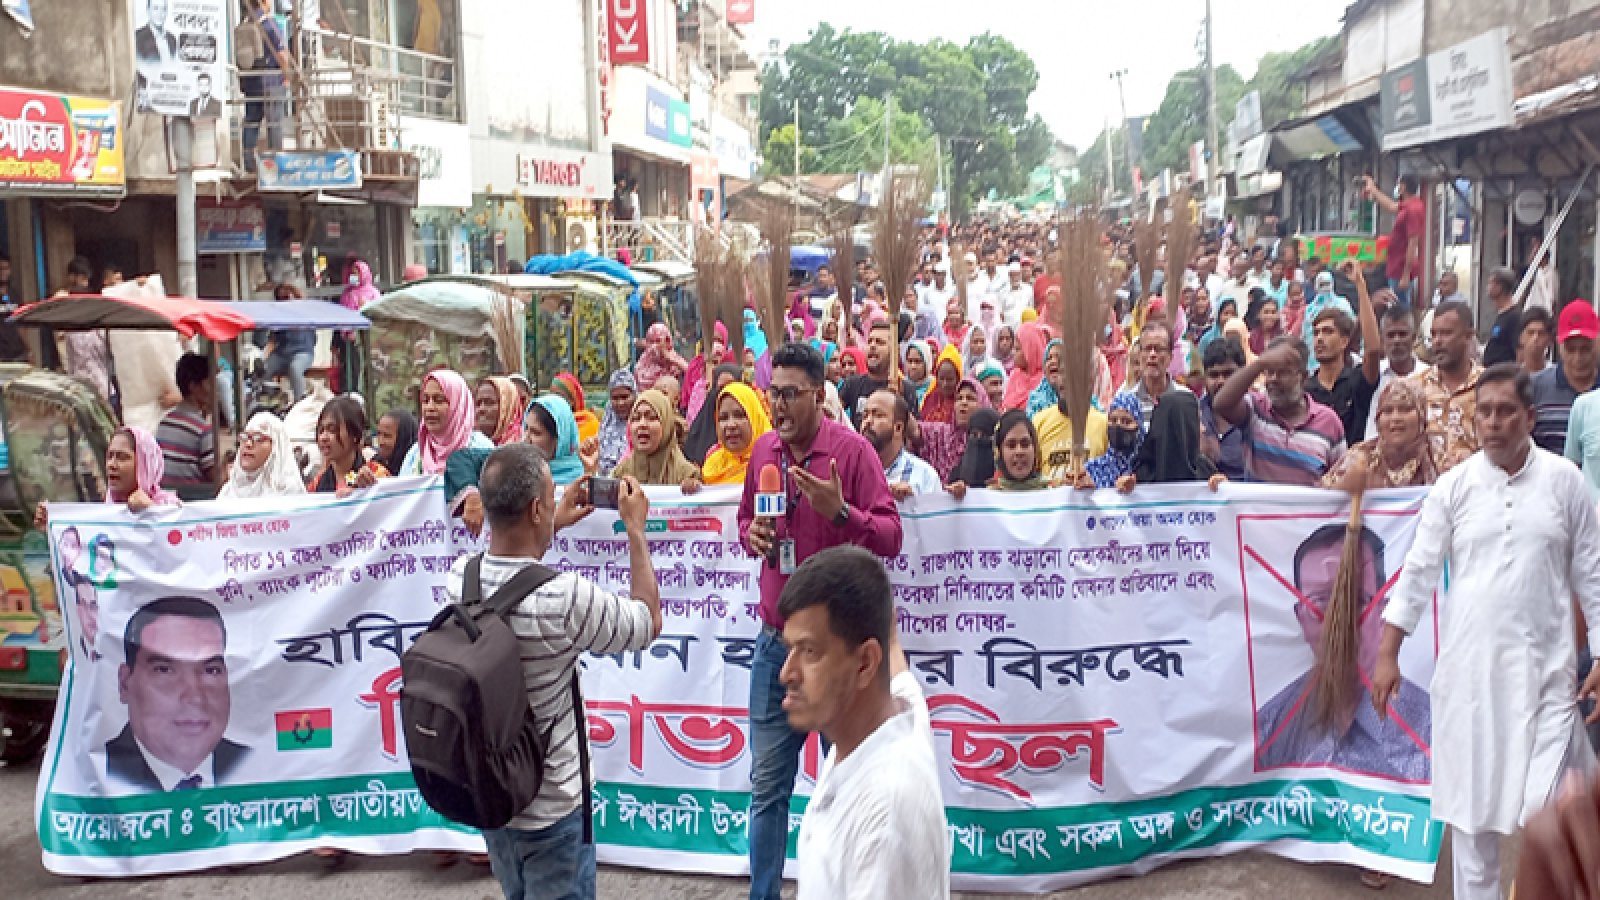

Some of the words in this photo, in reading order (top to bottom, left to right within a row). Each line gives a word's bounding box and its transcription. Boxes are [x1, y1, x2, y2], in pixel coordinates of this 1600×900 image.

[224, 548, 261, 573] বিগত
[267, 550, 286, 570] ১৭
[290, 545, 322, 565] বছর
[920, 550, 974, 574] রাজপথে
[978, 550, 1002, 569] রক্ত
[1146, 544, 1172, 561] বাদ
[1176, 536, 1210, 562] দিয়ে
[692, 564, 750, 590] উপজেলা
[1019, 574, 1066, 601] কমিটি
[1118, 568, 1178, 594] প্রতিবাদে
[1182, 571, 1216, 592] এবং
[975, 638, 1192, 692] বিরুদ্ধে
[51, 808, 173, 844] আয়োজনে
[202, 794, 321, 832] বাংলাদেশ
[617, 790, 704, 836] ঈশ্বরদী
[995, 829, 1051, 860] এবং
[1058, 820, 1122, 854] সকল
[1211, 786, 1314, 829] সহযোগী
[1324, 794, 1414, 837] সংগঠন
